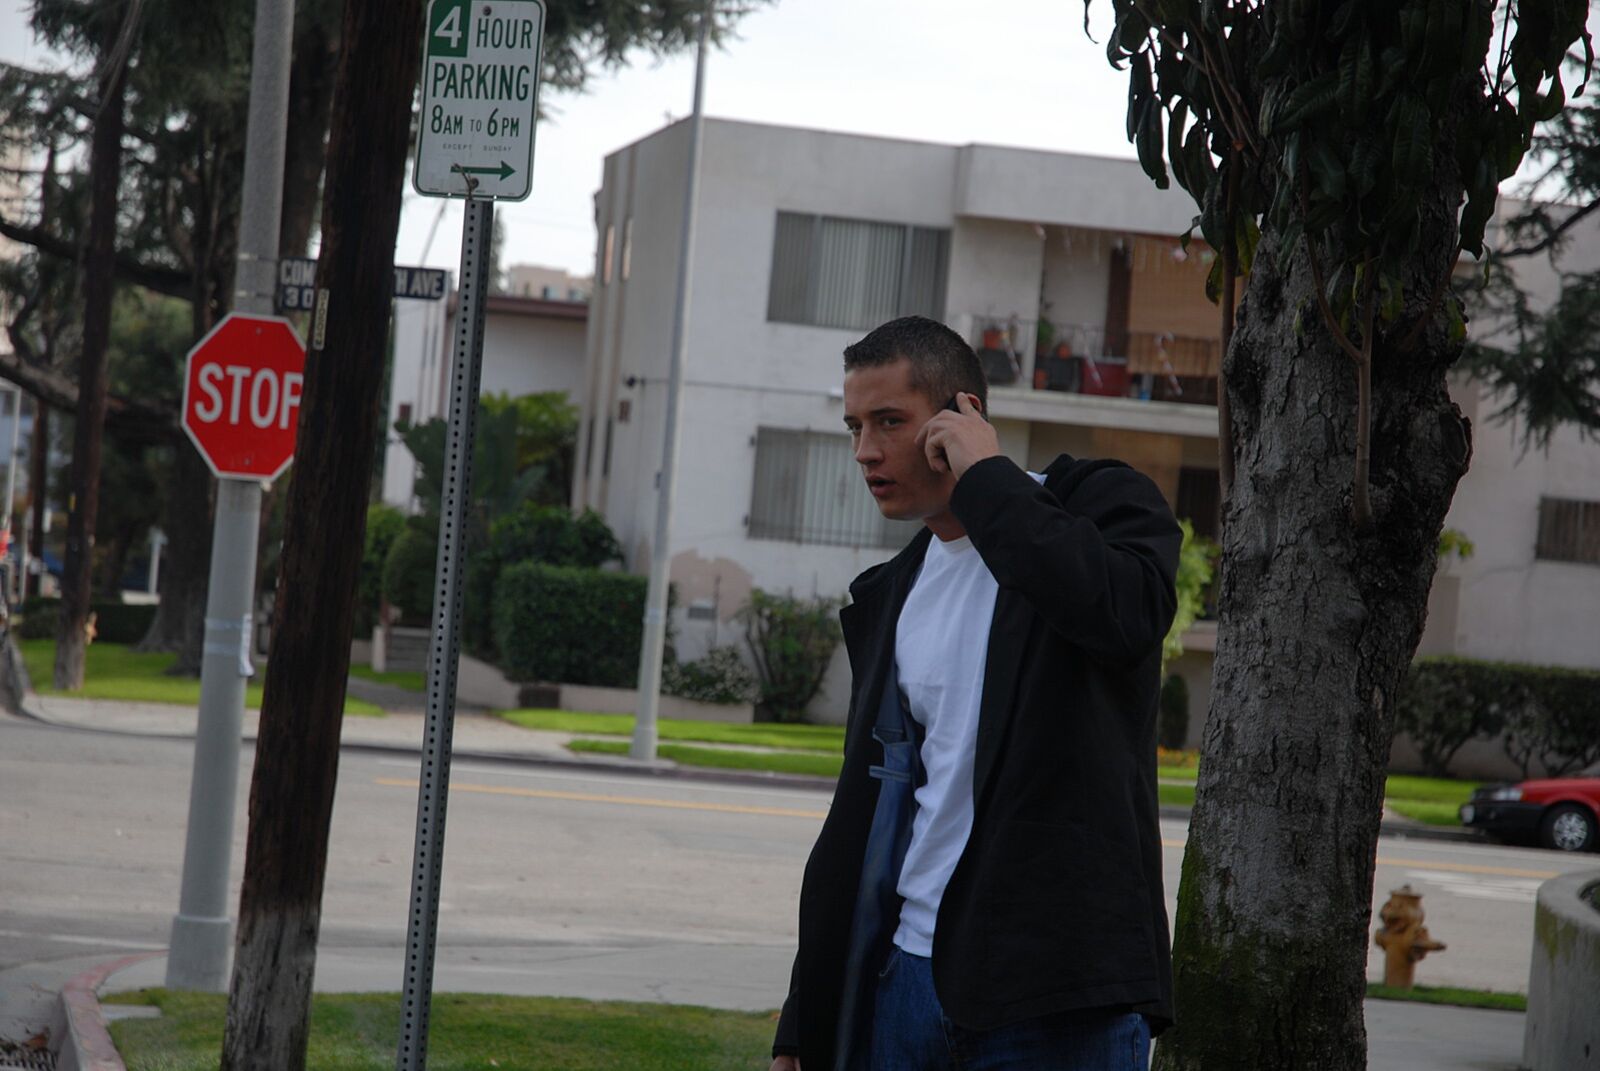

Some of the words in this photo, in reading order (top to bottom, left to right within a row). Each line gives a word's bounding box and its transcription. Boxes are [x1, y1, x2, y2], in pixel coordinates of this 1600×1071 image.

[434, 5, 463, 49] 4
[476, 18, 534, 49] HOUR
[432, 63, 531, 101] PARKING
[431, 104, 464, 135] 8AM
[470, 119, 483, 133] TO
[409, 270, 444, 299] AVE
[194, 361, 304, 431] STOP
